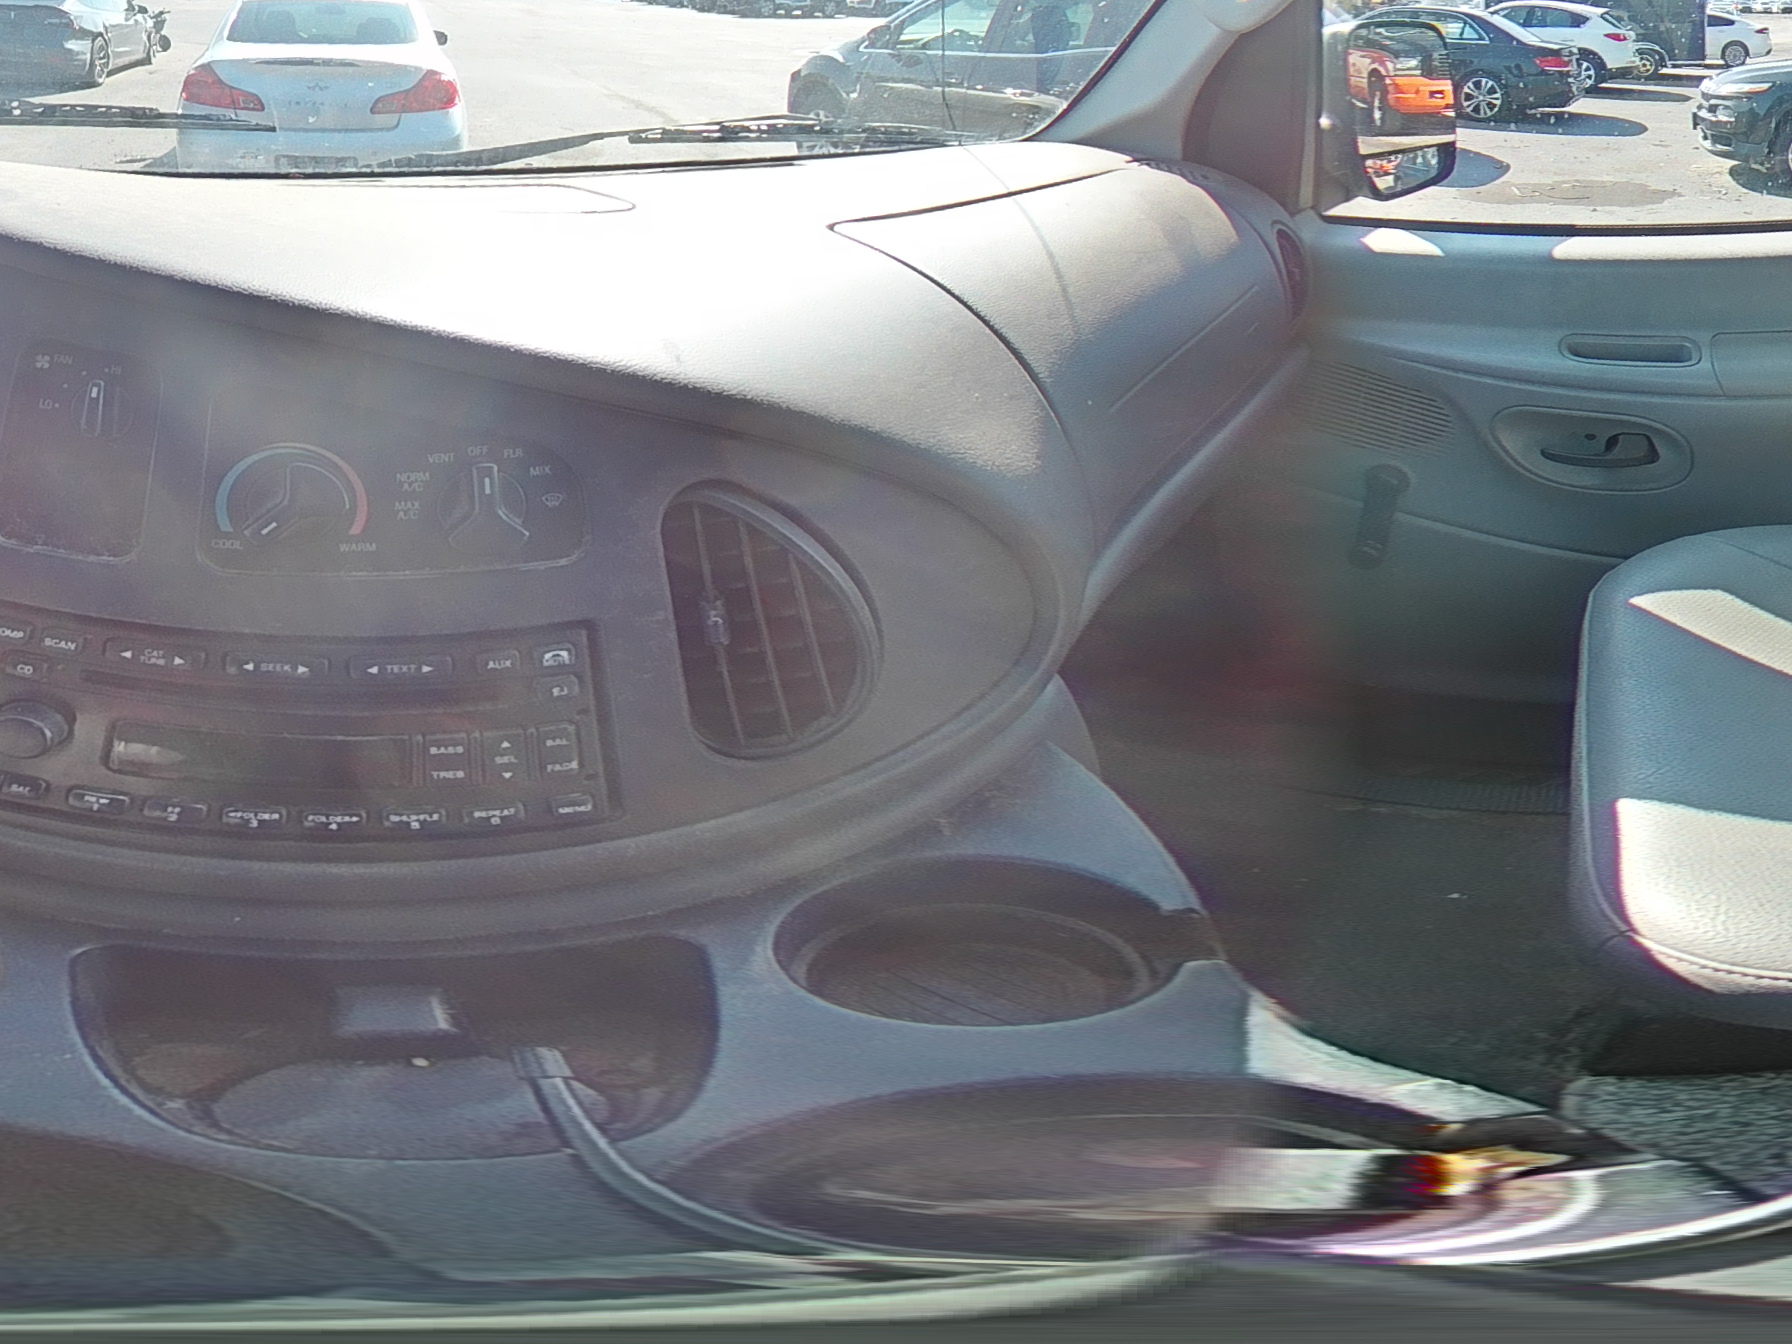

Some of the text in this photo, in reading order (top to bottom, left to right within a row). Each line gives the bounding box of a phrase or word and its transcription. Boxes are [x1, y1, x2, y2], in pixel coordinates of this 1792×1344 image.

[468, 446, 489, 456] OFF
[504, 449, 523, 458] FLR
[427, 453, 455, 463] VENT
[530, 466, 552, 477] MIX
[397, 472, 430, 482] NORM
[403, 483, 423, 491] A/C
[395, 501, 420, 510] MAX
[398, 511, 418, 520] A/C
[211, 538, 244, 550] COOL
[339, 542, 377, 552] WARM
[44, 637, 76, 651] SCAN
[16, 664, 33, 675] CD
[260, 663, 291, 672] SEEK
[386, 665, 416, 673] TEXT
[487, 660, 512, 669] AUX
[430, 746, 464, 754] BASS
[547, 759, 578, 772] FADE
[431, 770, 465, 779] TREB
[473, 807, 516, 818] REPEAT
